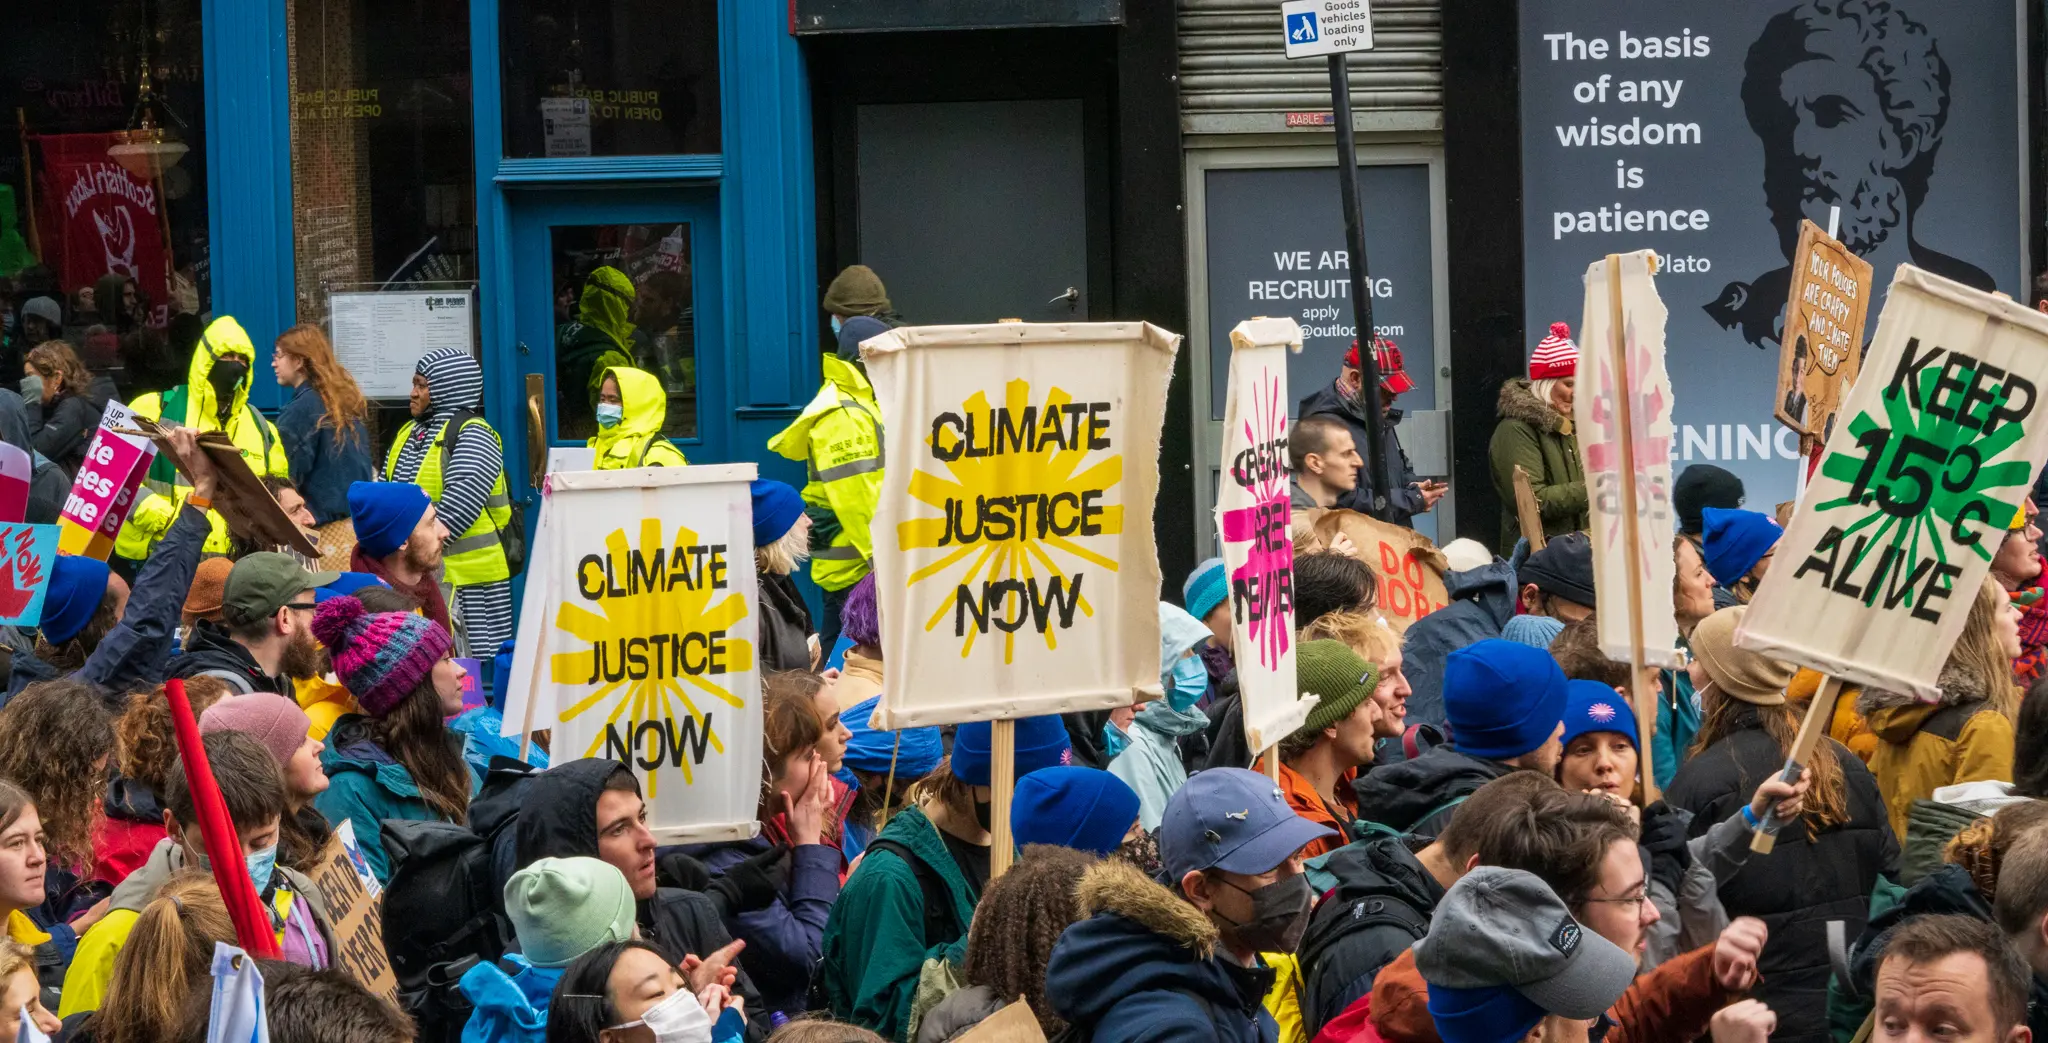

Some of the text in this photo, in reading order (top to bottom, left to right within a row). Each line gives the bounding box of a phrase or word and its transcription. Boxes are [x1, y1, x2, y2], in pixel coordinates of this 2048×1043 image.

[1321, 11, 1366, 24] vehicles
[1325, 0, 1360, 11] Goods
[1324, 24, 1364, 36] loading
[1334, 36, 1357, 47] only
[1543, 28, 1710, 61] The basis
[1574, 74, 1683, 108] of any
[1555, 116, 1702, 147] wisdom
[1617, 159, 1644, 189] is
[1554, 202, 1710, 240] patience
[1274, 251, 1350, 270] WE AR
[1810, 250, 1858, 299] YOUR POLICIES
[1249, 278, 1393, 300] RECRUITG
[1803, 282, 1850, 325] ARE CRAPPY
[1302, 305, 1340, 321] apply
[1809, 311, 1850, 352] AND I HATE
[1818, 343, 1839, 370] THEM
[1886, 336, 2037, 437] KEEP
[110, 408, 124, 422] UP
[931, 401, 1112, 462] CLIMATE
[938, 489, 1104, 547] JUSTICE
[15, 526, 44, 589] NOW
[577, 543, 728, 600] CLIMATE
[1379, 540, 1424, 591] DO
[1793, 524, 1963, 625] ALIVE
[955, 573, 1084, 637] NOW
[588, 630, 728, 686] JUSTICE
[606, 711, 712, 772] NOW
[333, 853, 363, 898] TO
[344, 924, 388, 987] YEAR
